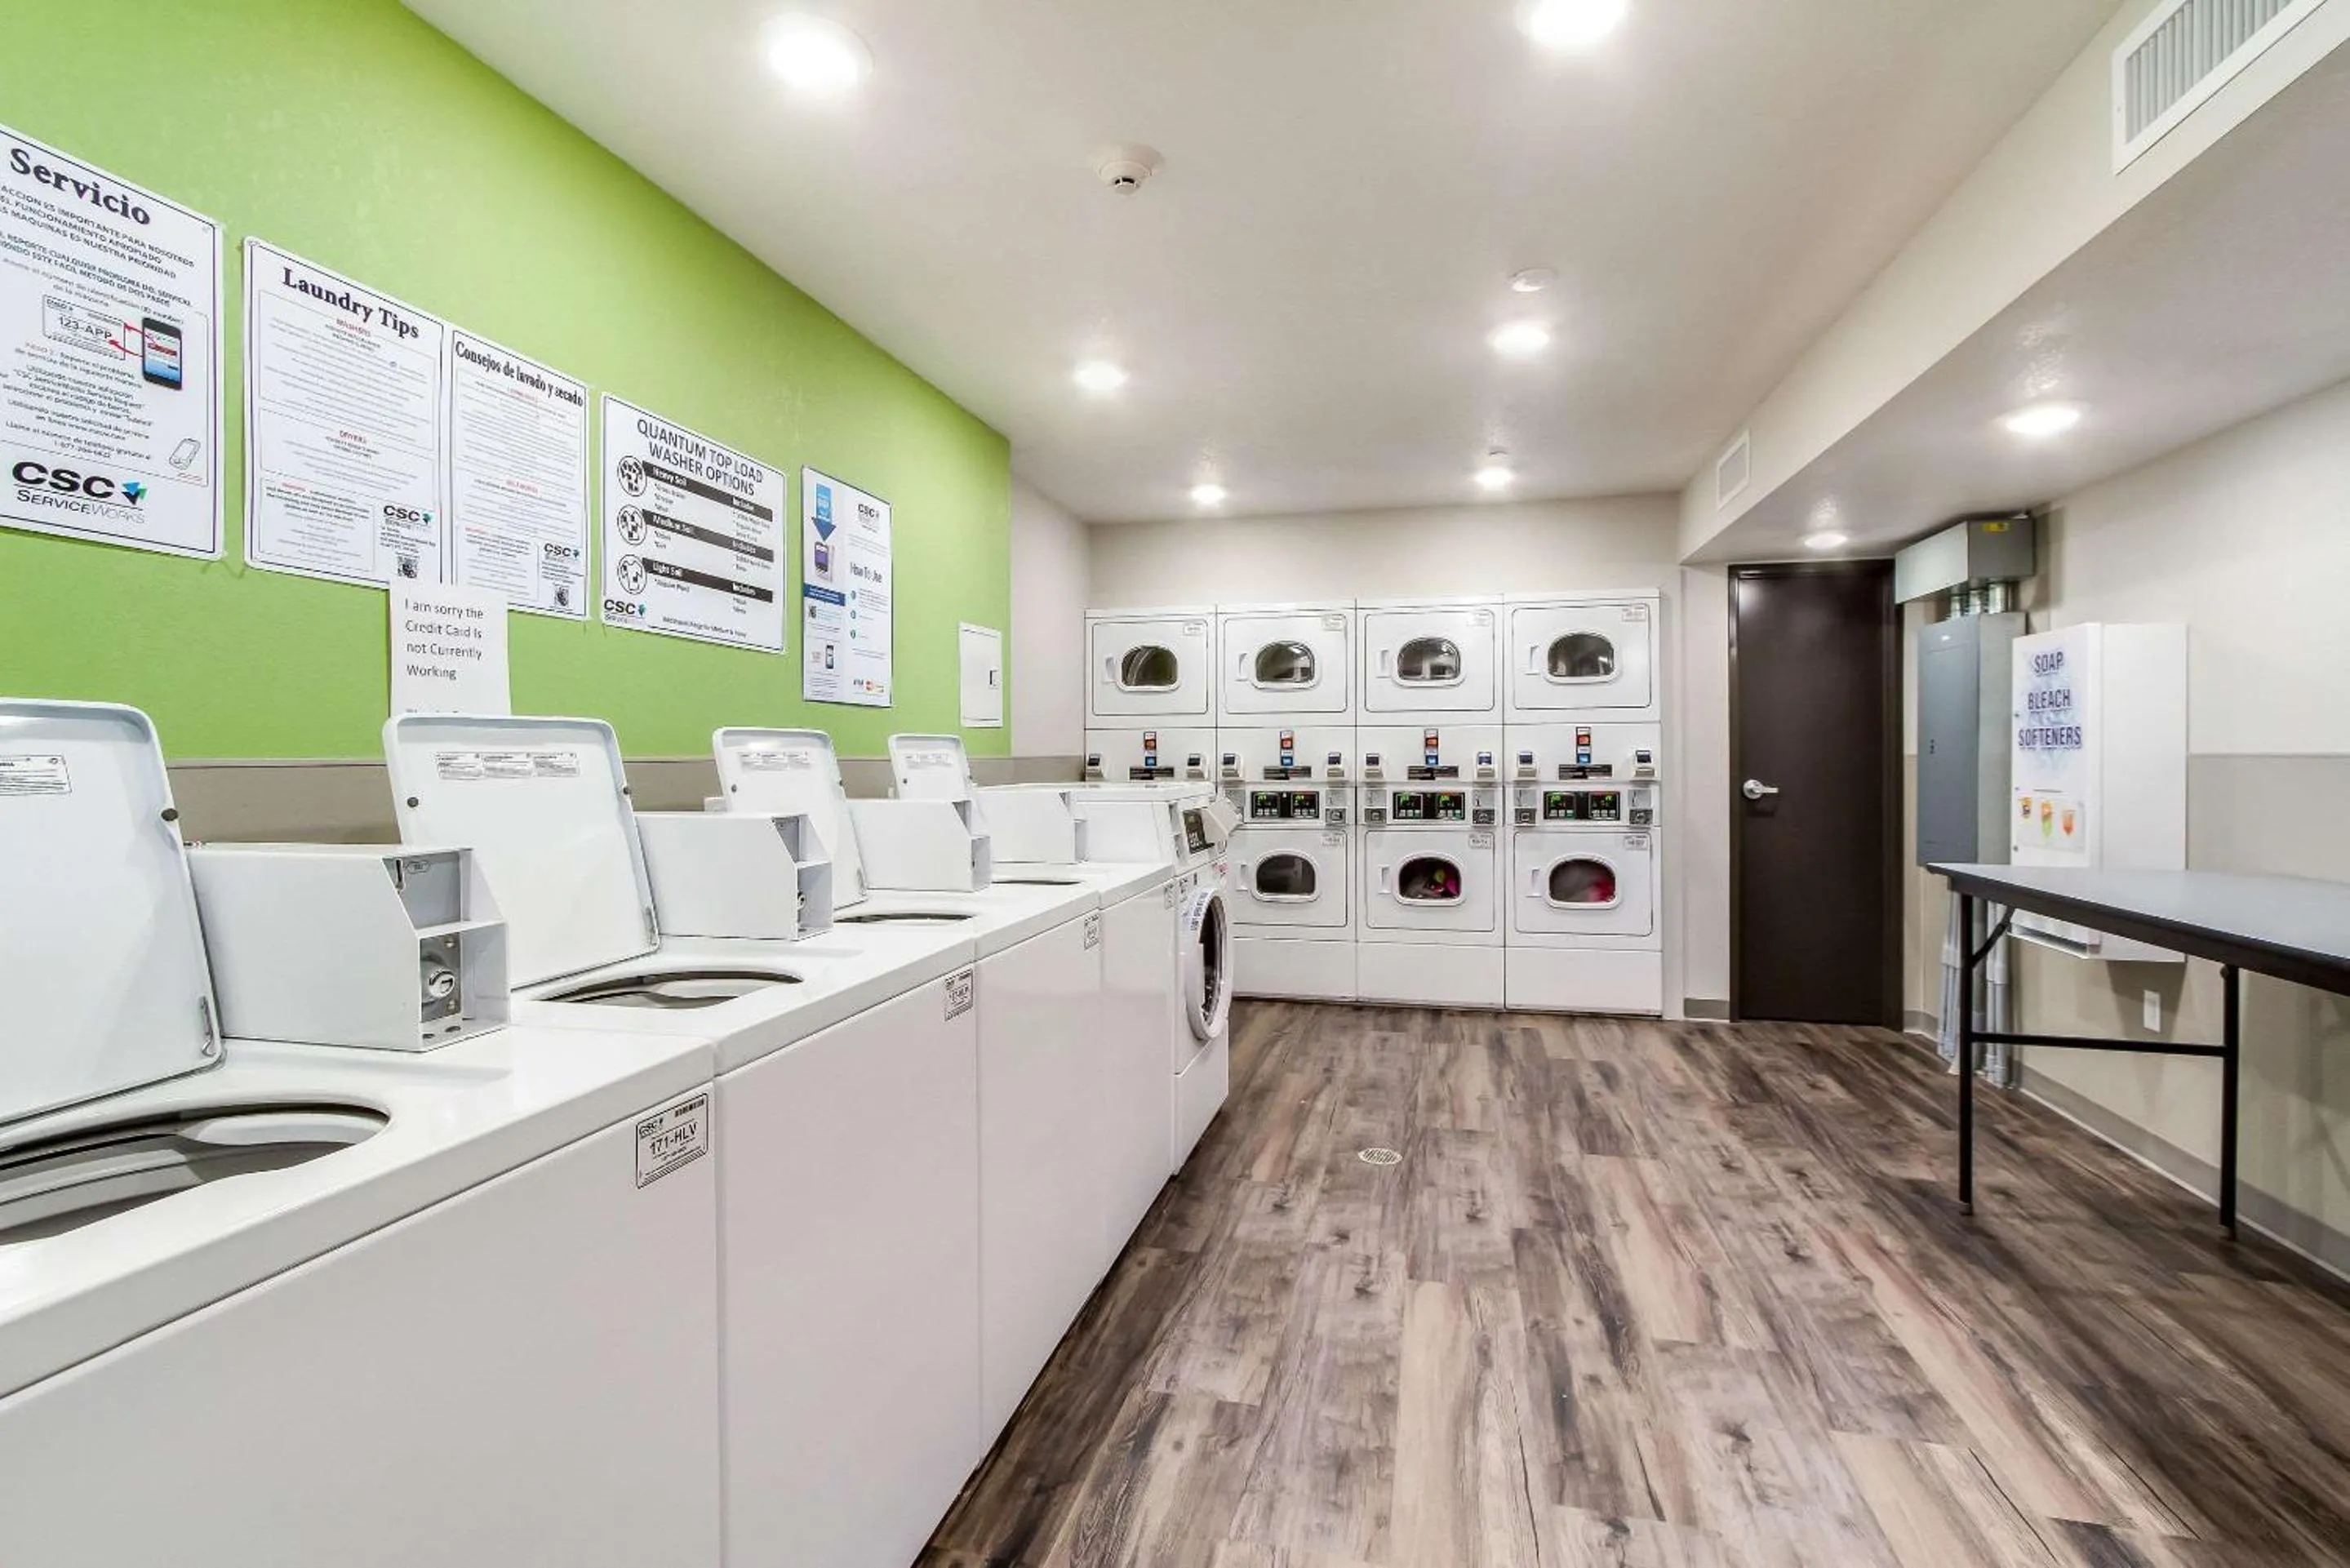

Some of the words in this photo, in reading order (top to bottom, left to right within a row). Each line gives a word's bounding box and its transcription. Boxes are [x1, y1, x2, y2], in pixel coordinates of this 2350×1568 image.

[10, 148, 150, 225] Servicio
[282, 267, 374, 323] Laundry
[379, 309, 420, 339] Tips
[60, 317, 112, 339] 123-APP
[455, 341, 501, 372] Consejos
[503, 362, 514, 379] de
[516, 366, 545, 392] lavado
[548, 384, 553, 398] y
[556, 387, 584, 407] secado
[637, 419, 705, 461] QUANTUM
[709, 450, 732, 469] TOP
[735, 460, 763, 483] LOAD
[649, 442, 703, 476] WASHER
[706, 466, 755, 495] OPTIONS
[12, 461, 115, 499] CSC
[384, 505, 420, 522] CSC
[544, 543, 571, 557] CSC
[405, 597, 408, 610] I
[413, 602, 431, 612] am
[434, 605, 463, 619] sorry
[466, 607, 483, 619] the
[604, 599, 635, 614] CSC
[406, 620, 442, 635] Credit
[446, 624, 470, 637] Card
[406, 643, 427, 654] not
[430, 643, 482, 660] Currently
[2034, 651, 2063, 673] SOAP
[406, 664, 456, 680] Working
[2028, 689, 2071, 710] BLEACH
[2018, 726, 2082, 747] SOFTENERS
[649, 1122, 698, 1155] 171-HLV
